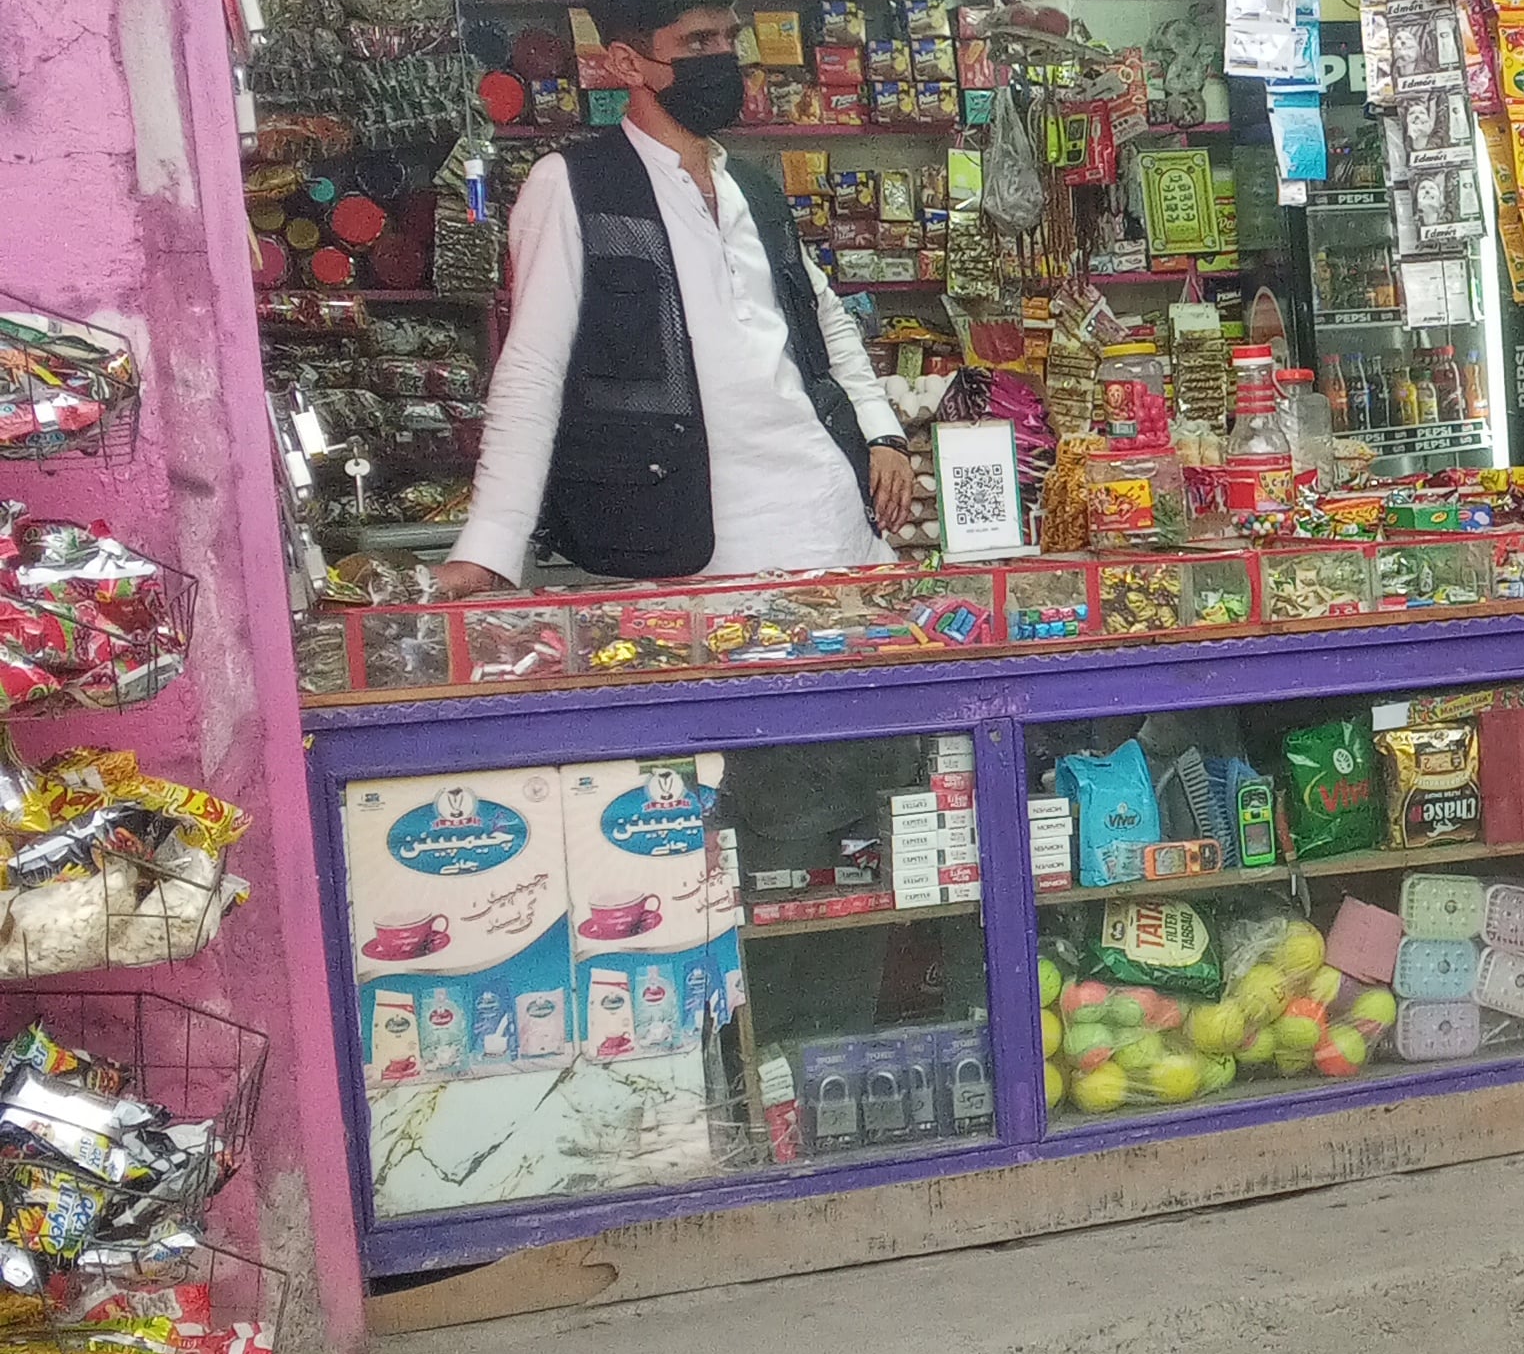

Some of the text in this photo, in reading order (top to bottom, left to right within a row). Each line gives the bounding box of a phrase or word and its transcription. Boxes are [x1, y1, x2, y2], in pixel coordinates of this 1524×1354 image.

[1337, 194, 1374, 204] PEPSI
[1335, 313, 1371, 323] PEPSI
[1417, 425, 1453, 438] PEPSI
